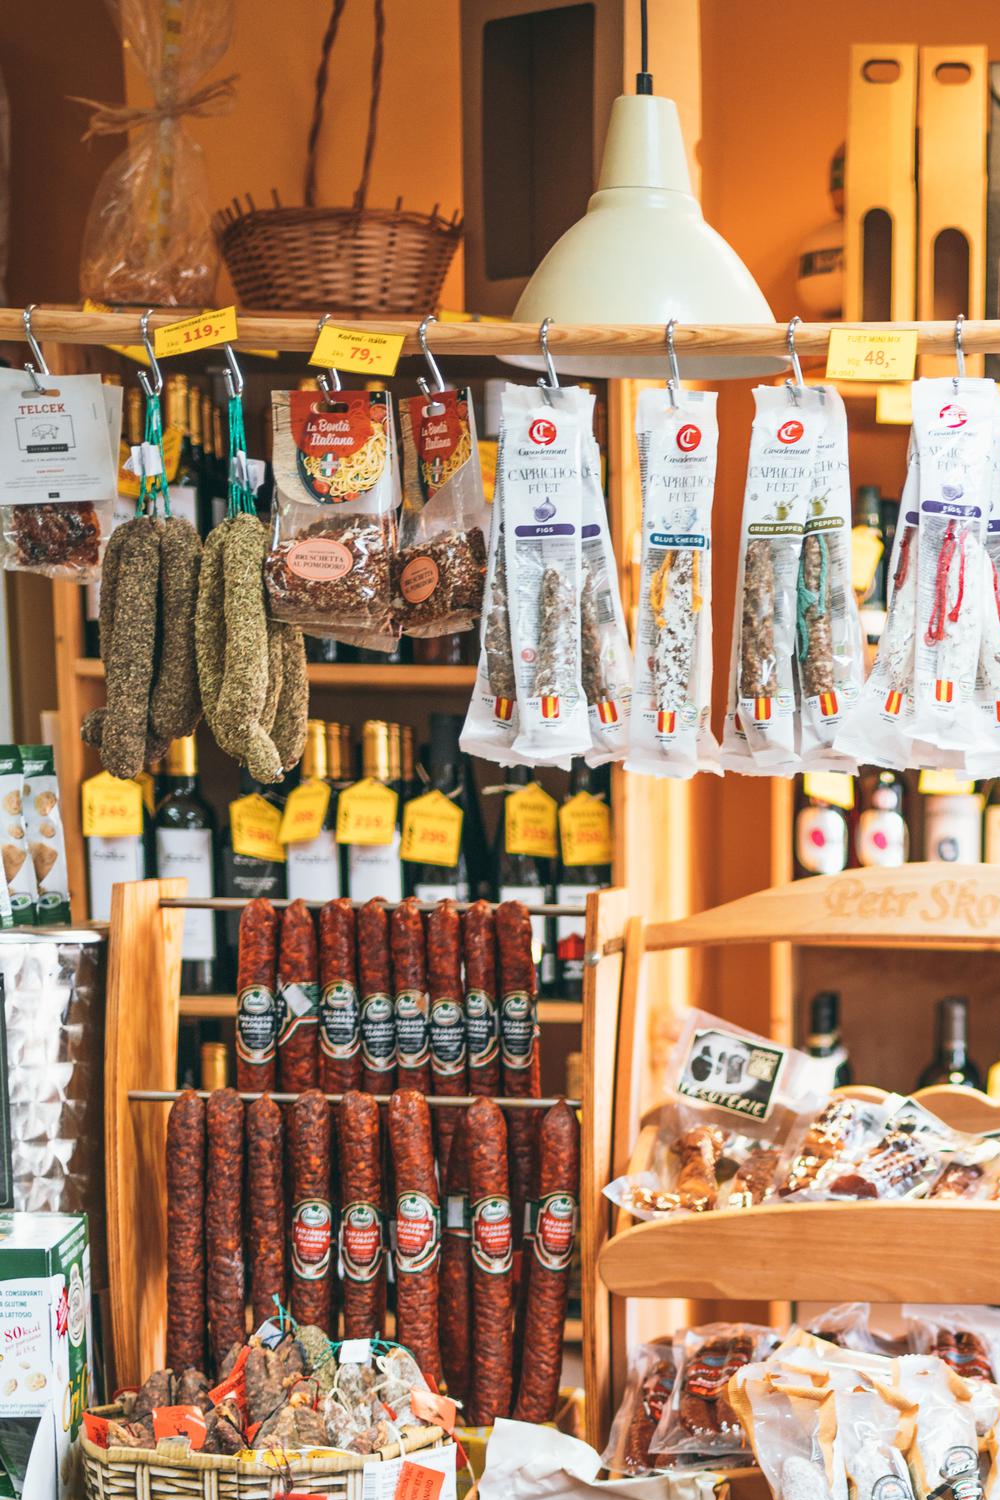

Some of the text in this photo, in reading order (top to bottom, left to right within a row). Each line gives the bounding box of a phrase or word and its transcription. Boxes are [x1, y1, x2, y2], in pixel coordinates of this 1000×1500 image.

[183, 324, 226, 343] 119,-
[338, 333, 363, 343] Koření
[350, 347, 382, 365] 79,-
[864, 350, 897, 369] 48,-
[18, 403, 66, 415] TELCEK
[306, 419, 350, 433] La Bontà
[310, 432, 355, 446] Italiana
[508, 467, 577, 482] CAPRICHOS
[750, 466, 812, 479] CAPRICHO
[528, 483, 561, 494] FUET
[766, 481, 798, 492] FUET
[750, 525, 803, 533] GREEN PEPPER
[814, 518, 843, 528] PEPPER
[675, 536, 704, 544] CHEESE
[679, 1083, 766, 1116] SUTERIE
